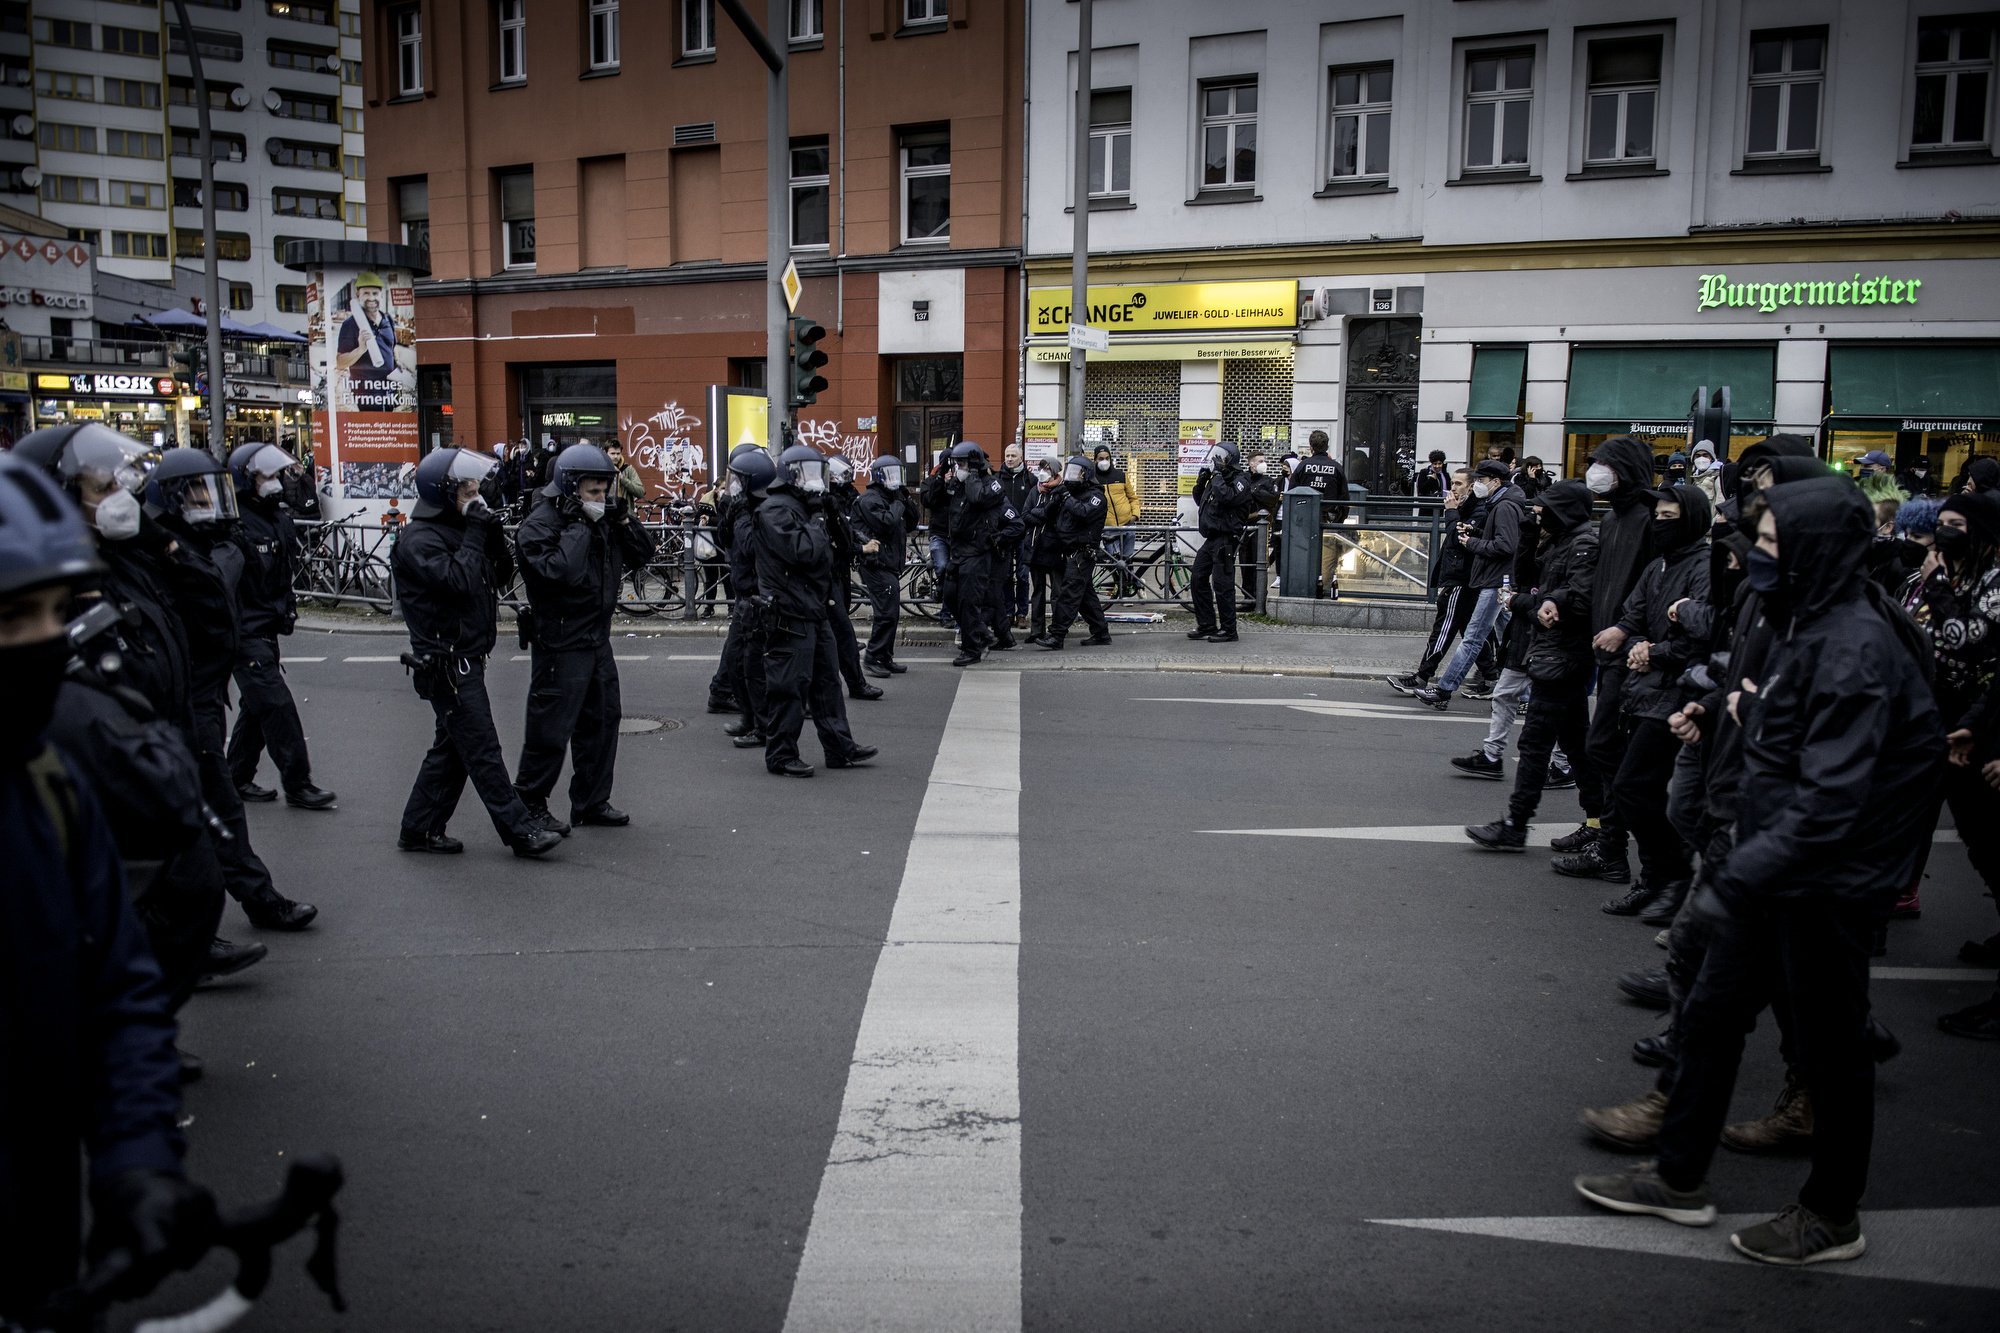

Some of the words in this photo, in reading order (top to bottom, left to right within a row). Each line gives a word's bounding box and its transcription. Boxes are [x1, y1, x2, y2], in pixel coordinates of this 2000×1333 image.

[1697, 273, 1922, 313] Burgermeister
[1132, 295, 1145, 305] AG
[1375, 302, 1390, 310] 136
[915, 312, 928, 321] 137
[1153, 310, 1198, 320] JUWELIER
[1204, 309, 1229, 319] GOLD
[1235, 307, 1284, 318] LEIHHAUS
[1197, 349, 1223, 358] Besser
[1223, 349, 1240, 357] hier.
[1241, 348, 1267, 357] Besser
[1267, 347, 1281, 356] wir.
[94, 375, 154, 390] KIOSK
[342, 377, 361, 390] Ihr
[365, 379, 403, 391] neues
[1629, 422, 1688, 434] Burgermeis
[1902, 419, 1983, 432] Burgermeister
[1305, 464, 1335, 475] POLIZEI
[1310, 481, 1327, 489] 12327
